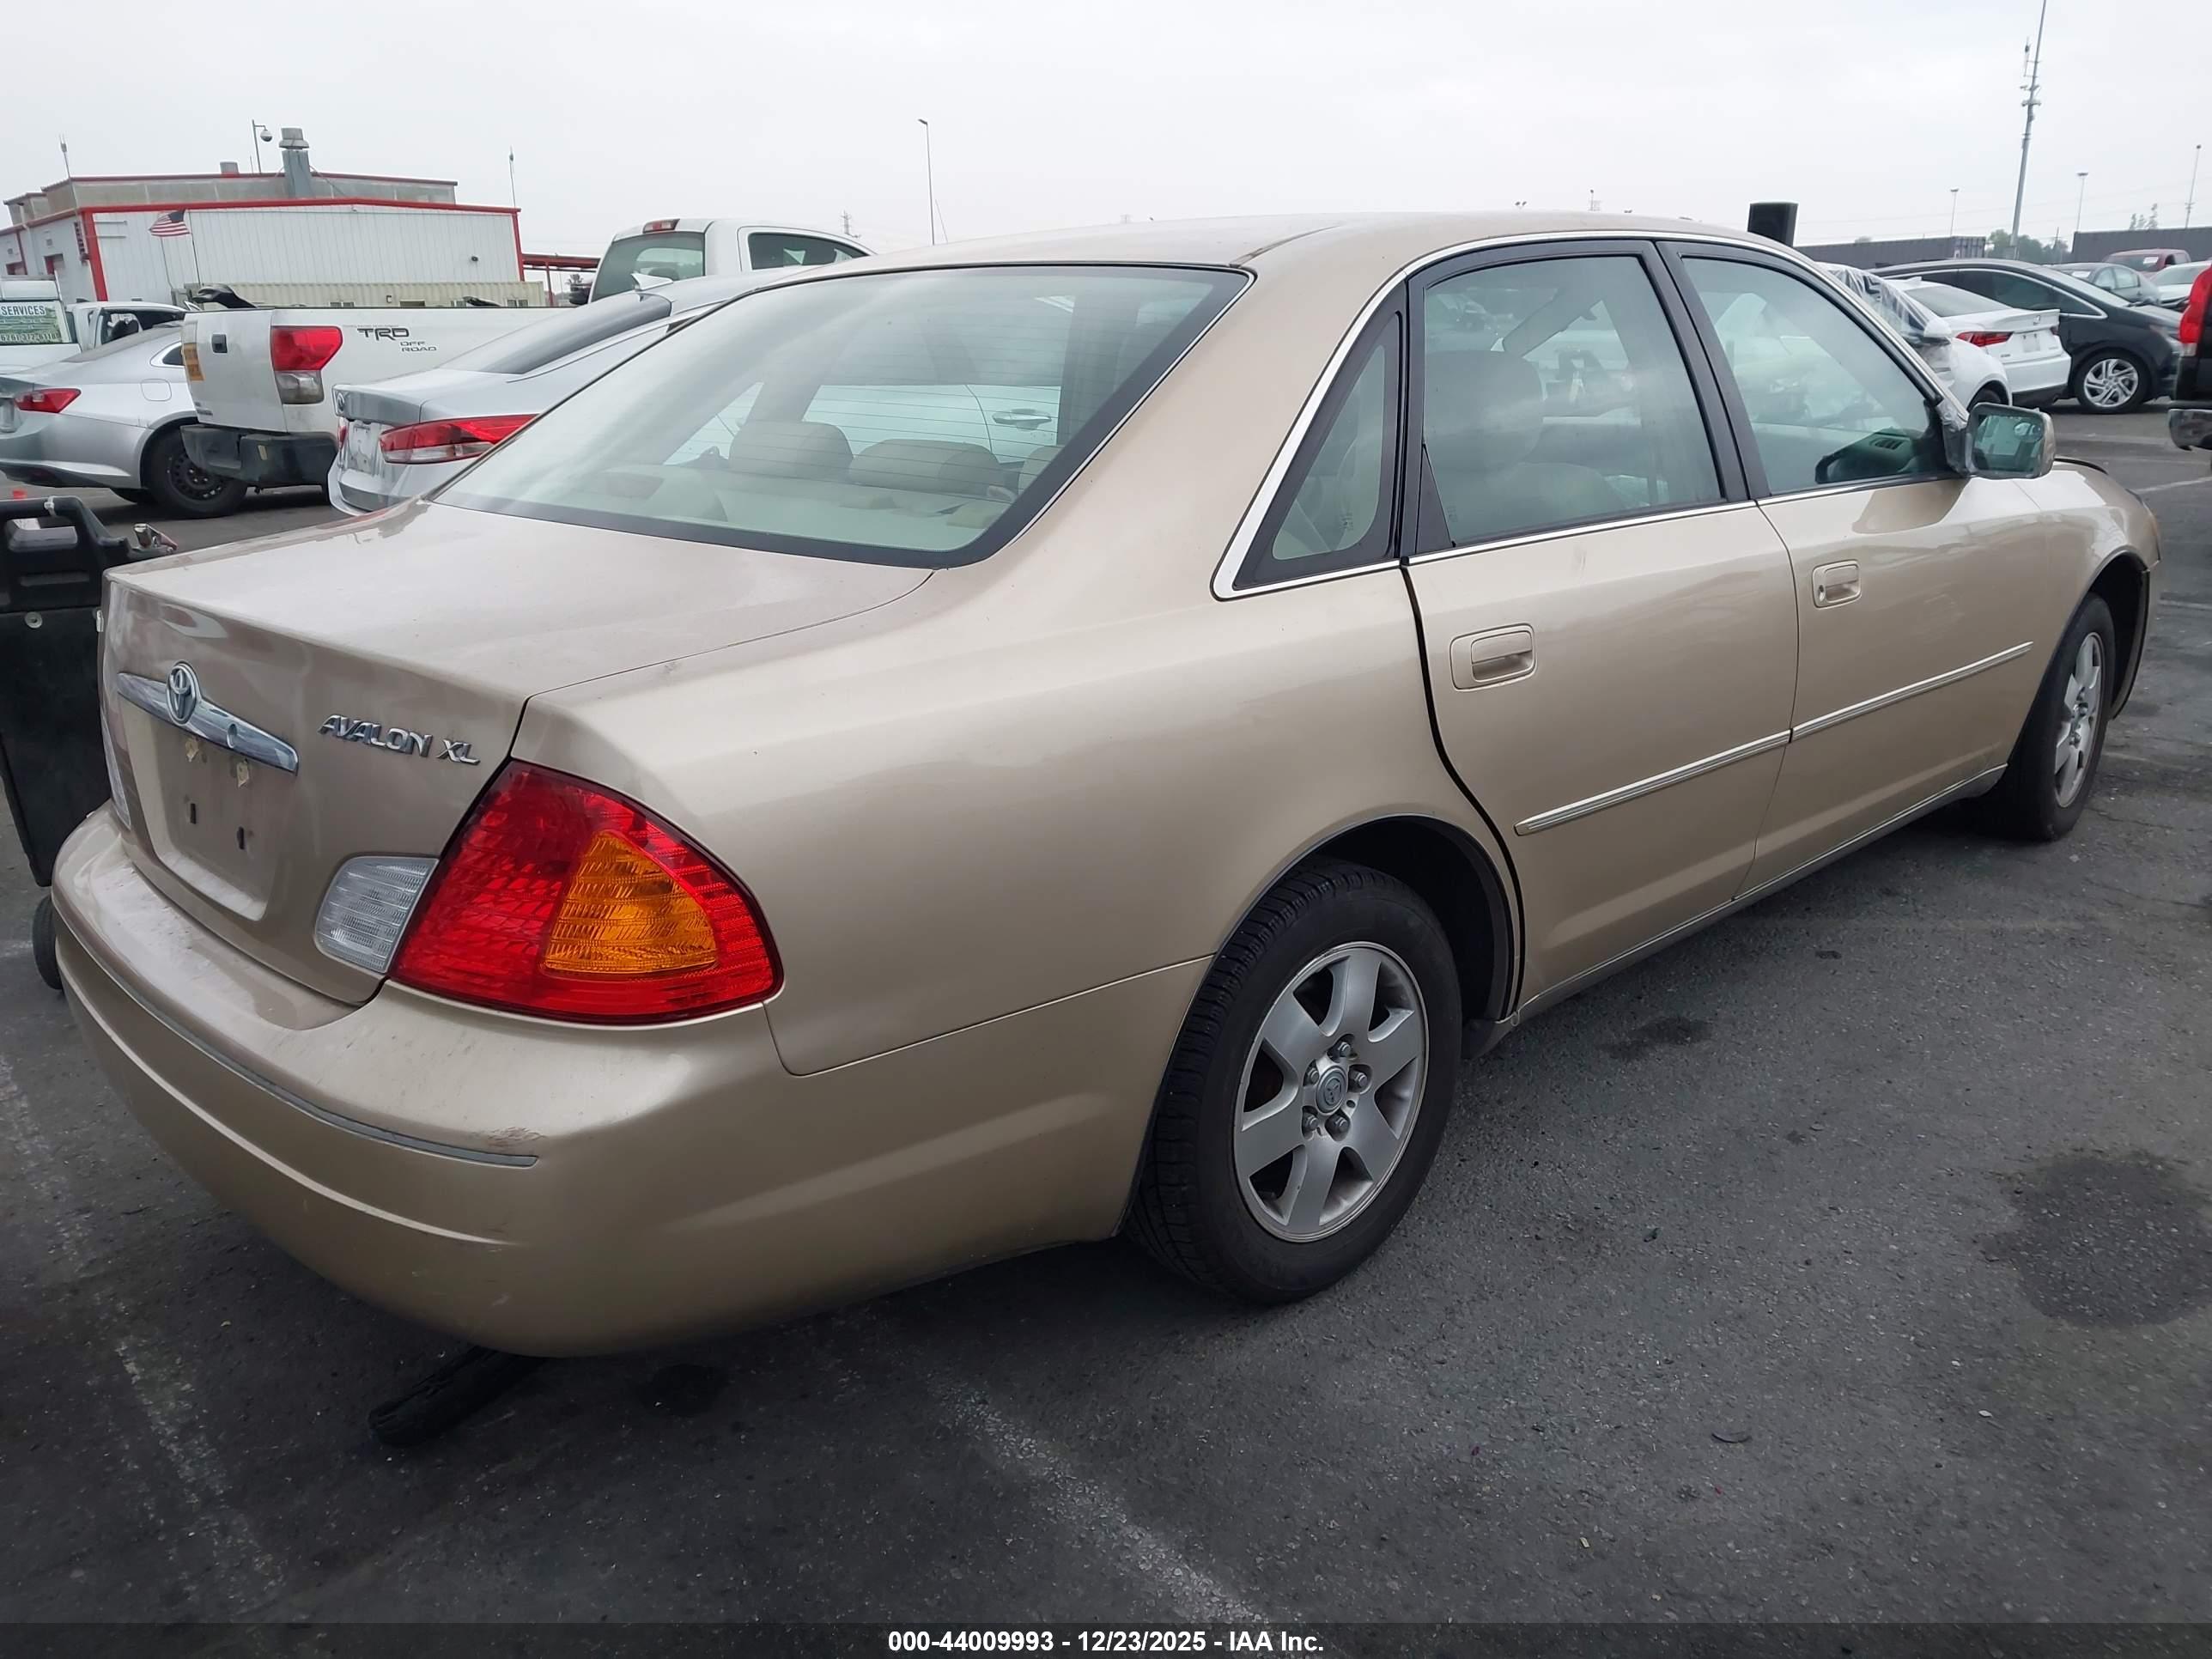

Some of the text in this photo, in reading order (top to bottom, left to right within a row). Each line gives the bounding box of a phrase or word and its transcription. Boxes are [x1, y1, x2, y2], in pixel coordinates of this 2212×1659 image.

[1, 306, 46, 316] SERVICES
[356, 327, 410, 341] TRD
[318, 714, 481, 766] AVALON XL
